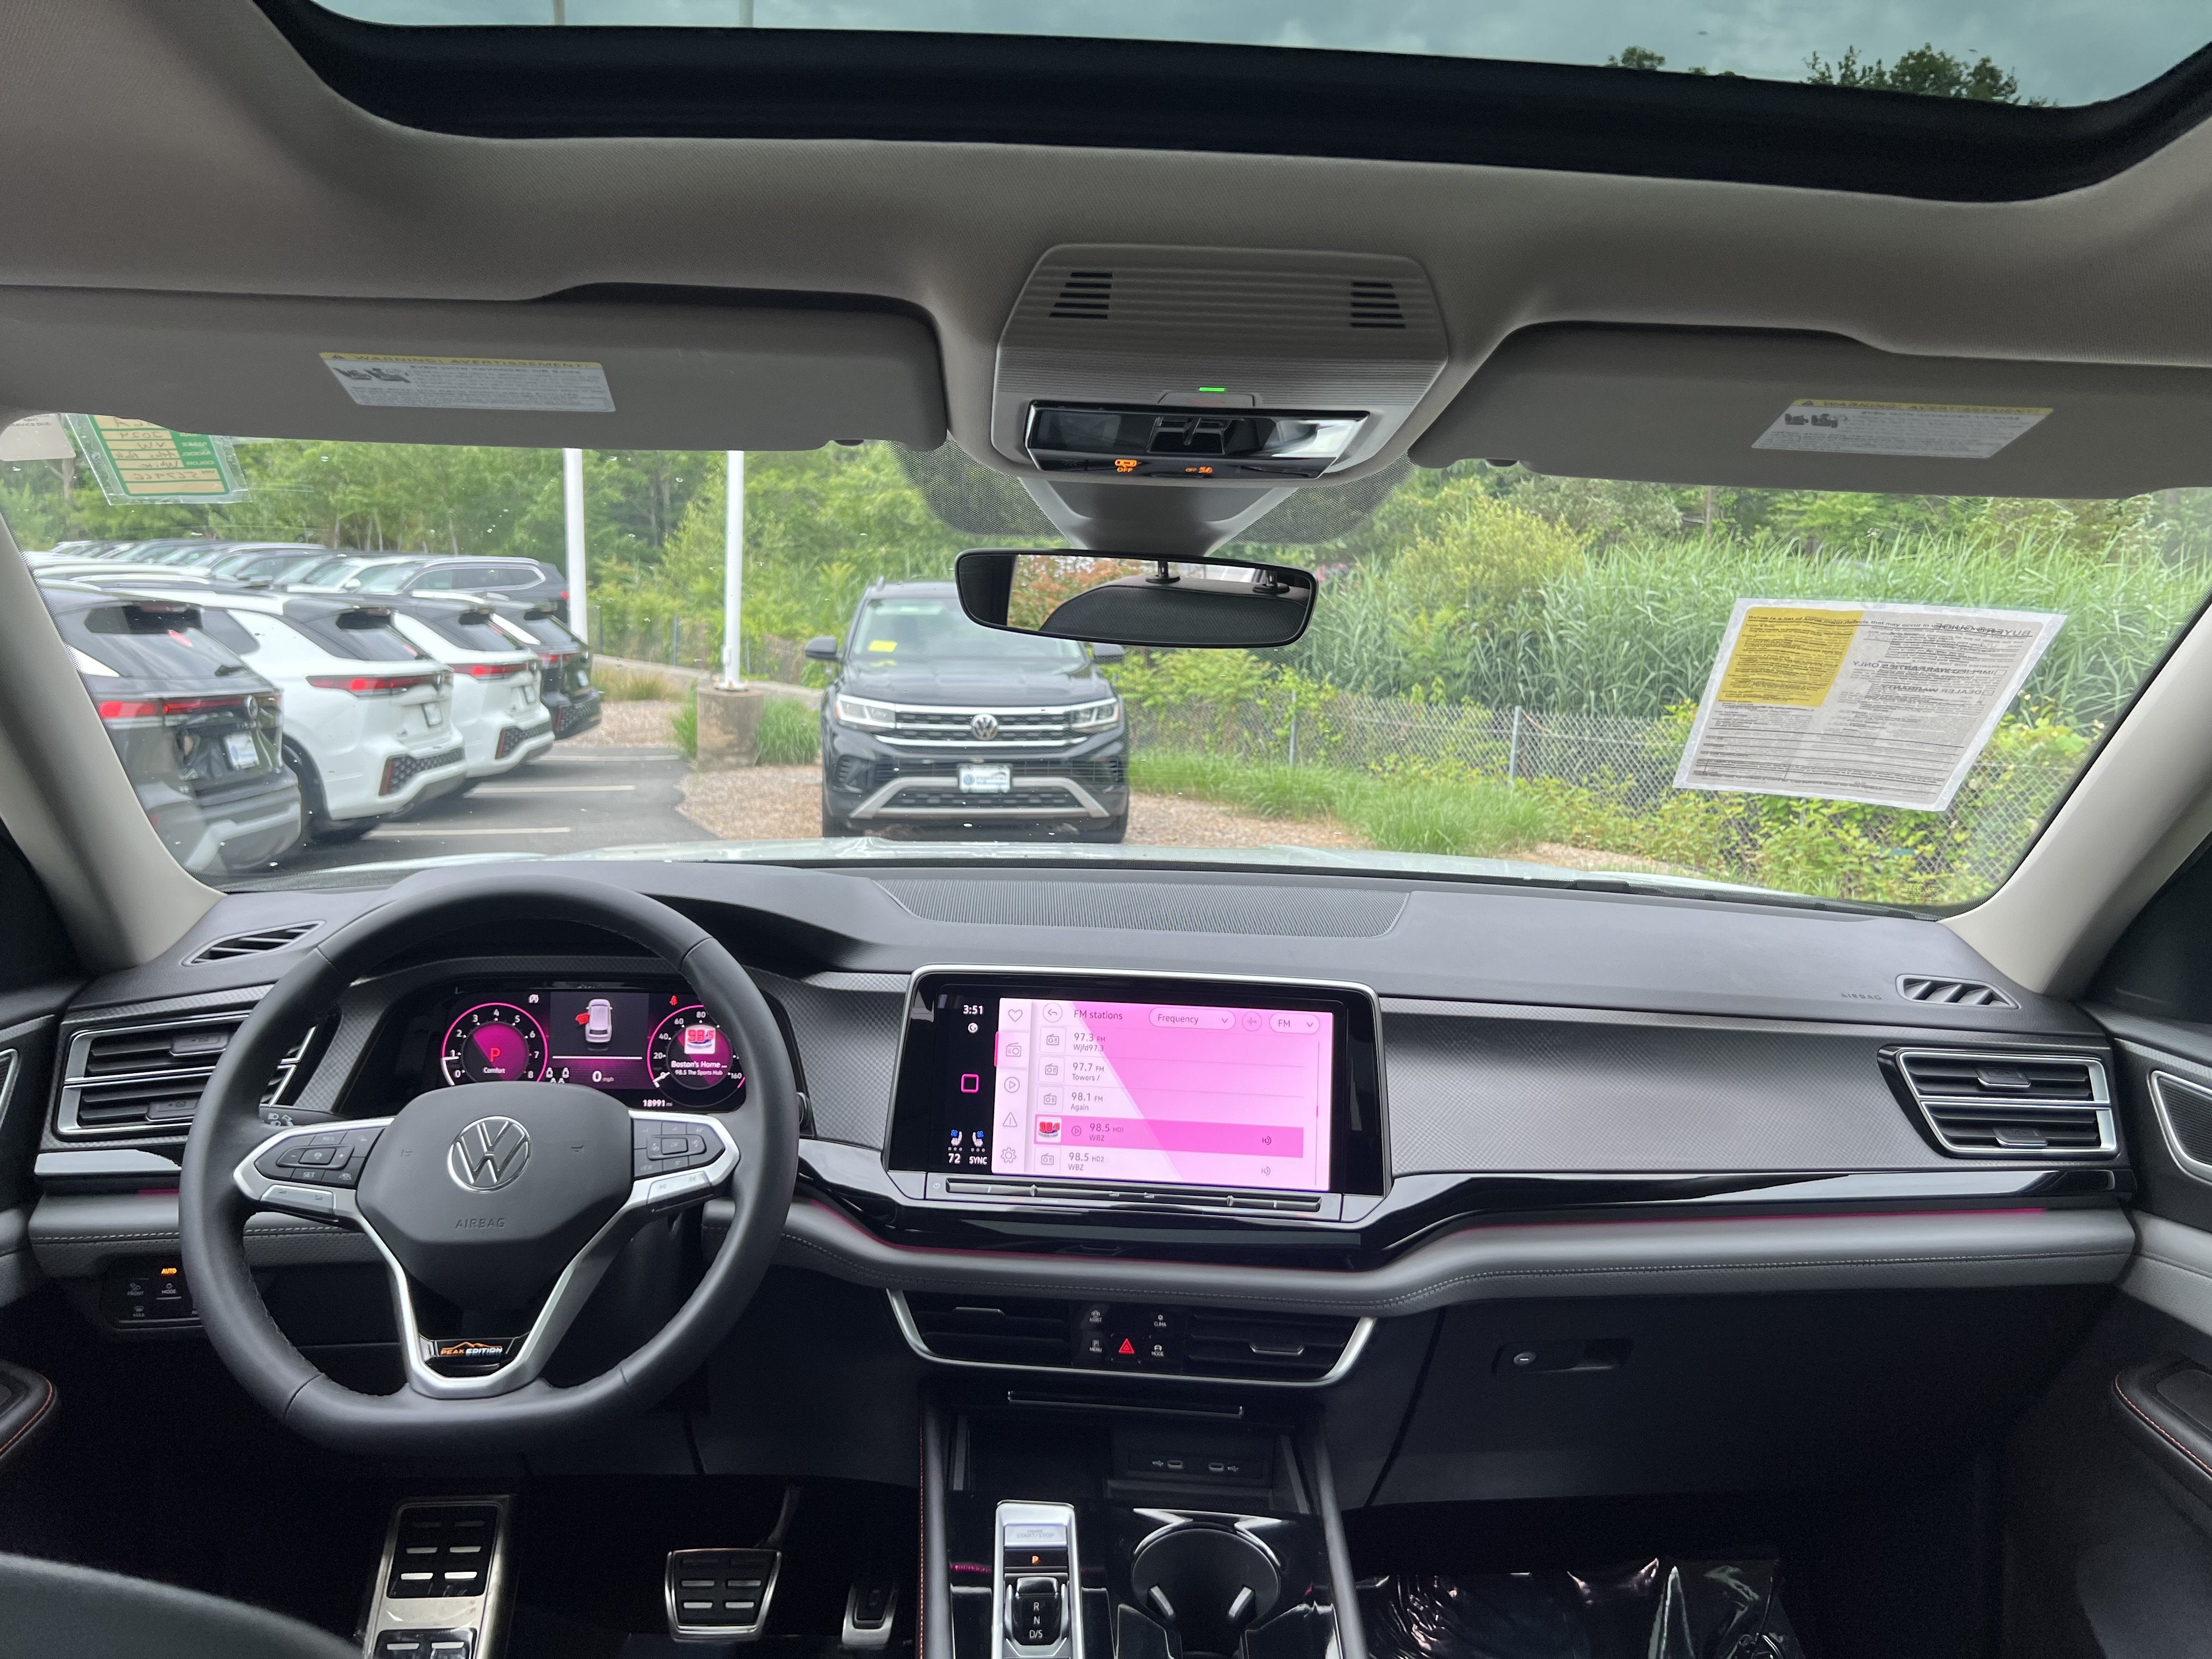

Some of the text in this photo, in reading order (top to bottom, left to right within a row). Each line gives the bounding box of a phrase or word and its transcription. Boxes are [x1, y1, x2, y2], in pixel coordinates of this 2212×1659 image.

[963, 1005, 984, 1015] 3:51
[1074, 1009, 1123, 1019] FM stations
[472, 1014, 478, 1023] 3
[1158, 1013, 1199, 1025] Frequency
[1278, 1019, 1290, 1028] FM
[529, 1030, 536, 1038] 6
[1074, 1033, 1094, 1042] 97.3
[490, 1047, 501, 1062] P
[534, 1051, 540, 1059] 7
[1073, 1062, 1093, 1071] 97.7
[527, 1070, 534, 1079] 8
[592, 1070, 602, 1082] 0
[1072, 1073, 1096, 1081] Towers
[1071, 1092, 1092, 1102] 98.1
[642, 1099, 665, 1107] 18991
[1089, 1123, 1110, 1132] 98.5
[948, 1153, 961, 1164] 72
[969, 1156, 988, 1165] SYNC
[1069, 1152, 1089, 1161] 98.5
[455, 1217, 506, 1229] AIRBAG
[465, 1347, 503, 1356] EDITION
[1032, 1555, 1039, 1564] P
[1033, 1602, 1040, 1611] R
[1034, 1616, 1041, 1624] N
[1029, 1629, 1043, 1639] D/S
